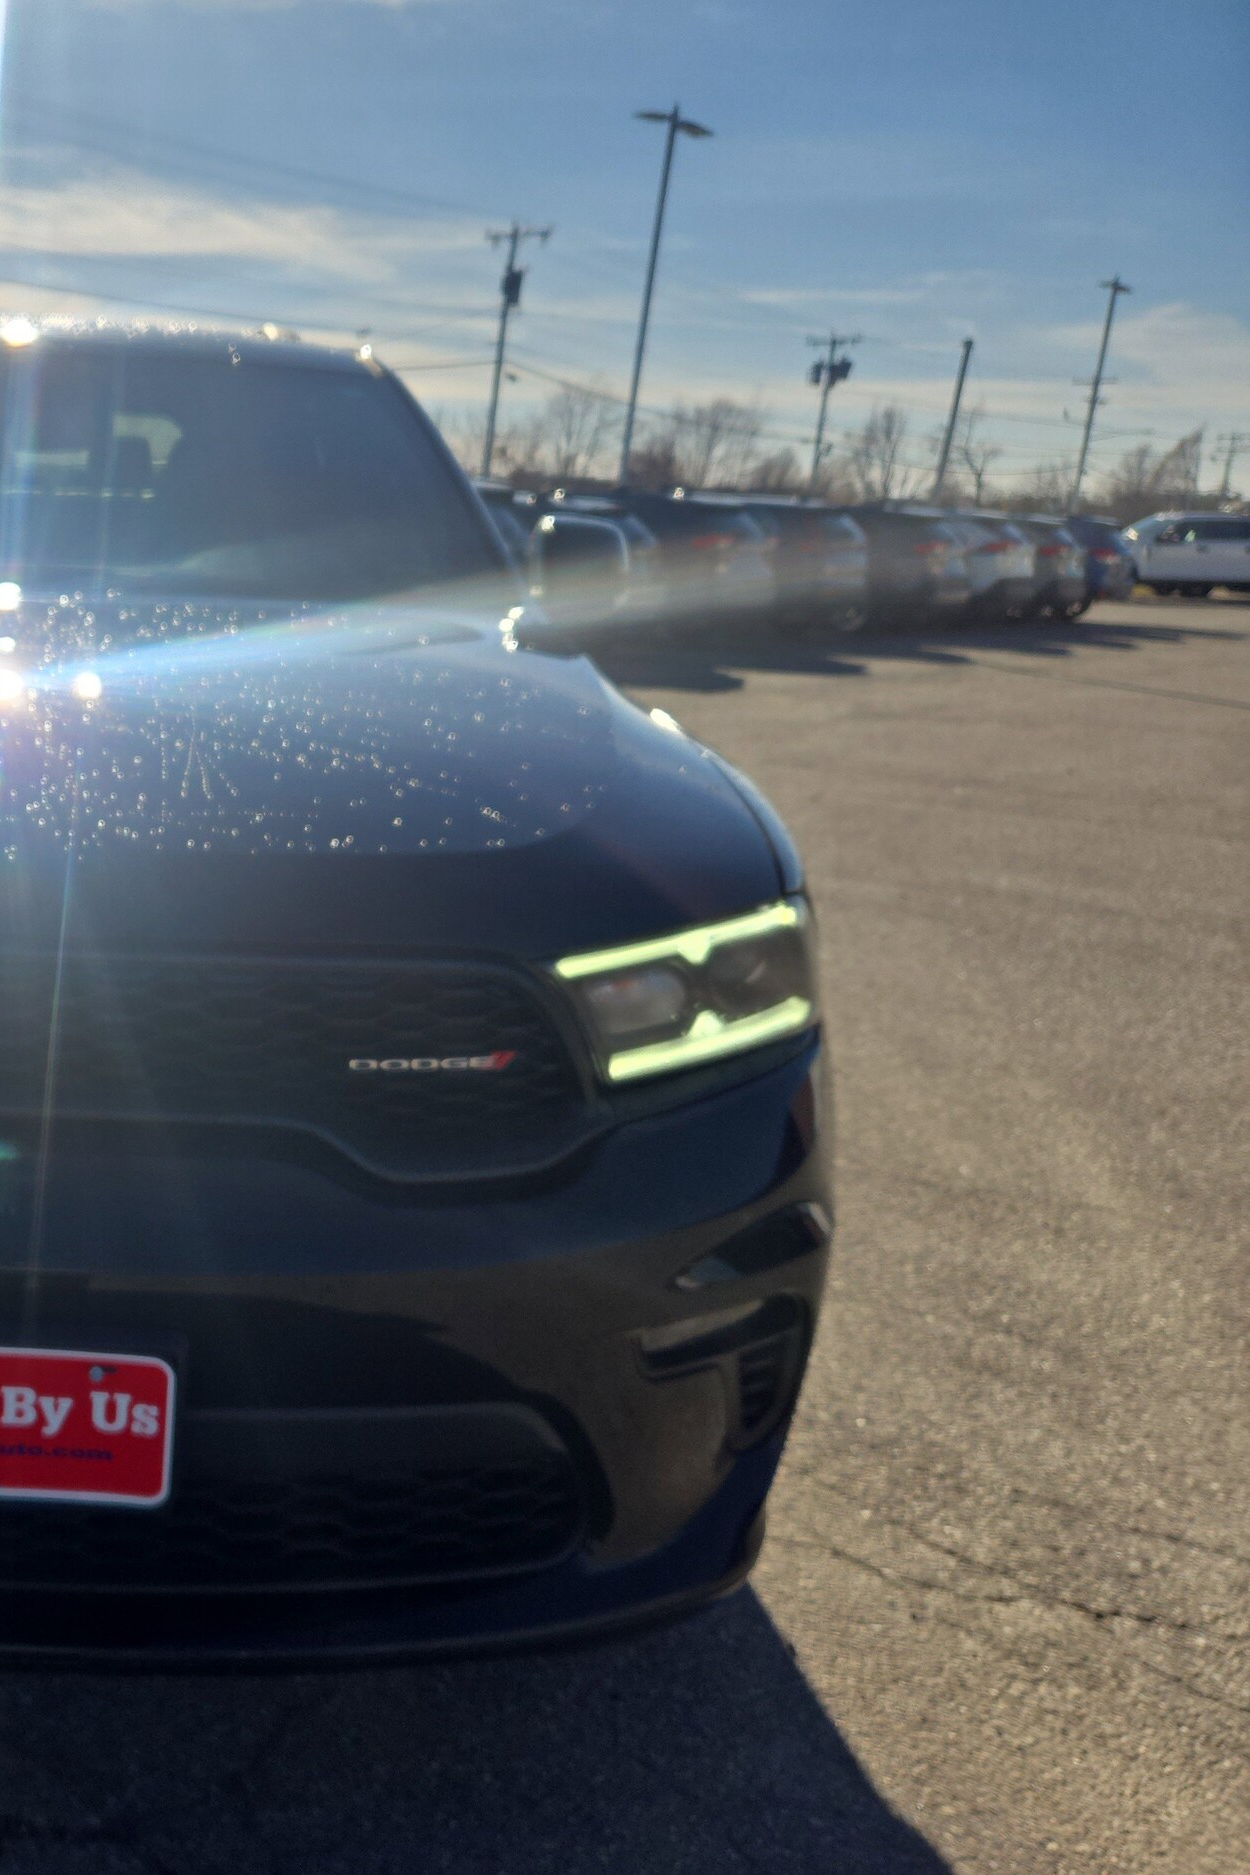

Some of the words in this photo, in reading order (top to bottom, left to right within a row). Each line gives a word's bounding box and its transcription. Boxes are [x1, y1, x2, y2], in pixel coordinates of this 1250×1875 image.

[348, 1056, 497, 1070] DODGE
[0, 1386, 73, 1436] By
[90, 1391, 159, 1436] Us
